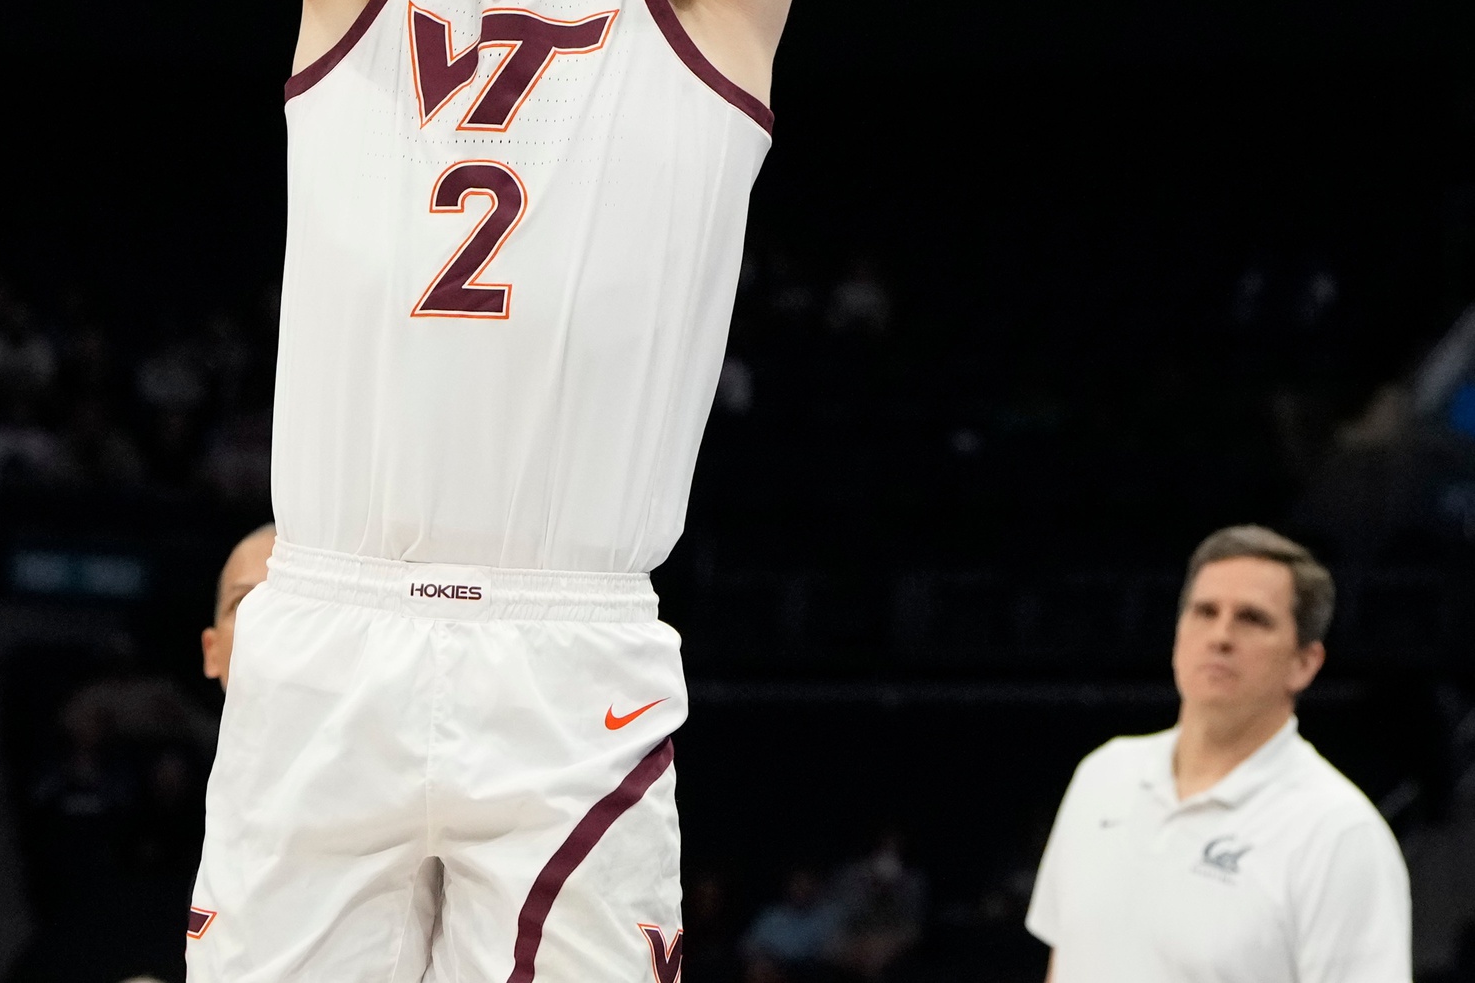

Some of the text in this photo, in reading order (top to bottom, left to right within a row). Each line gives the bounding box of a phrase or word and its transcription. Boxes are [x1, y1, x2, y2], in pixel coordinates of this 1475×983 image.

[409, 0, 620, 133] VT
[410, 159, 528, 319] 2
[410, 582, 483, 601] HOKIES
